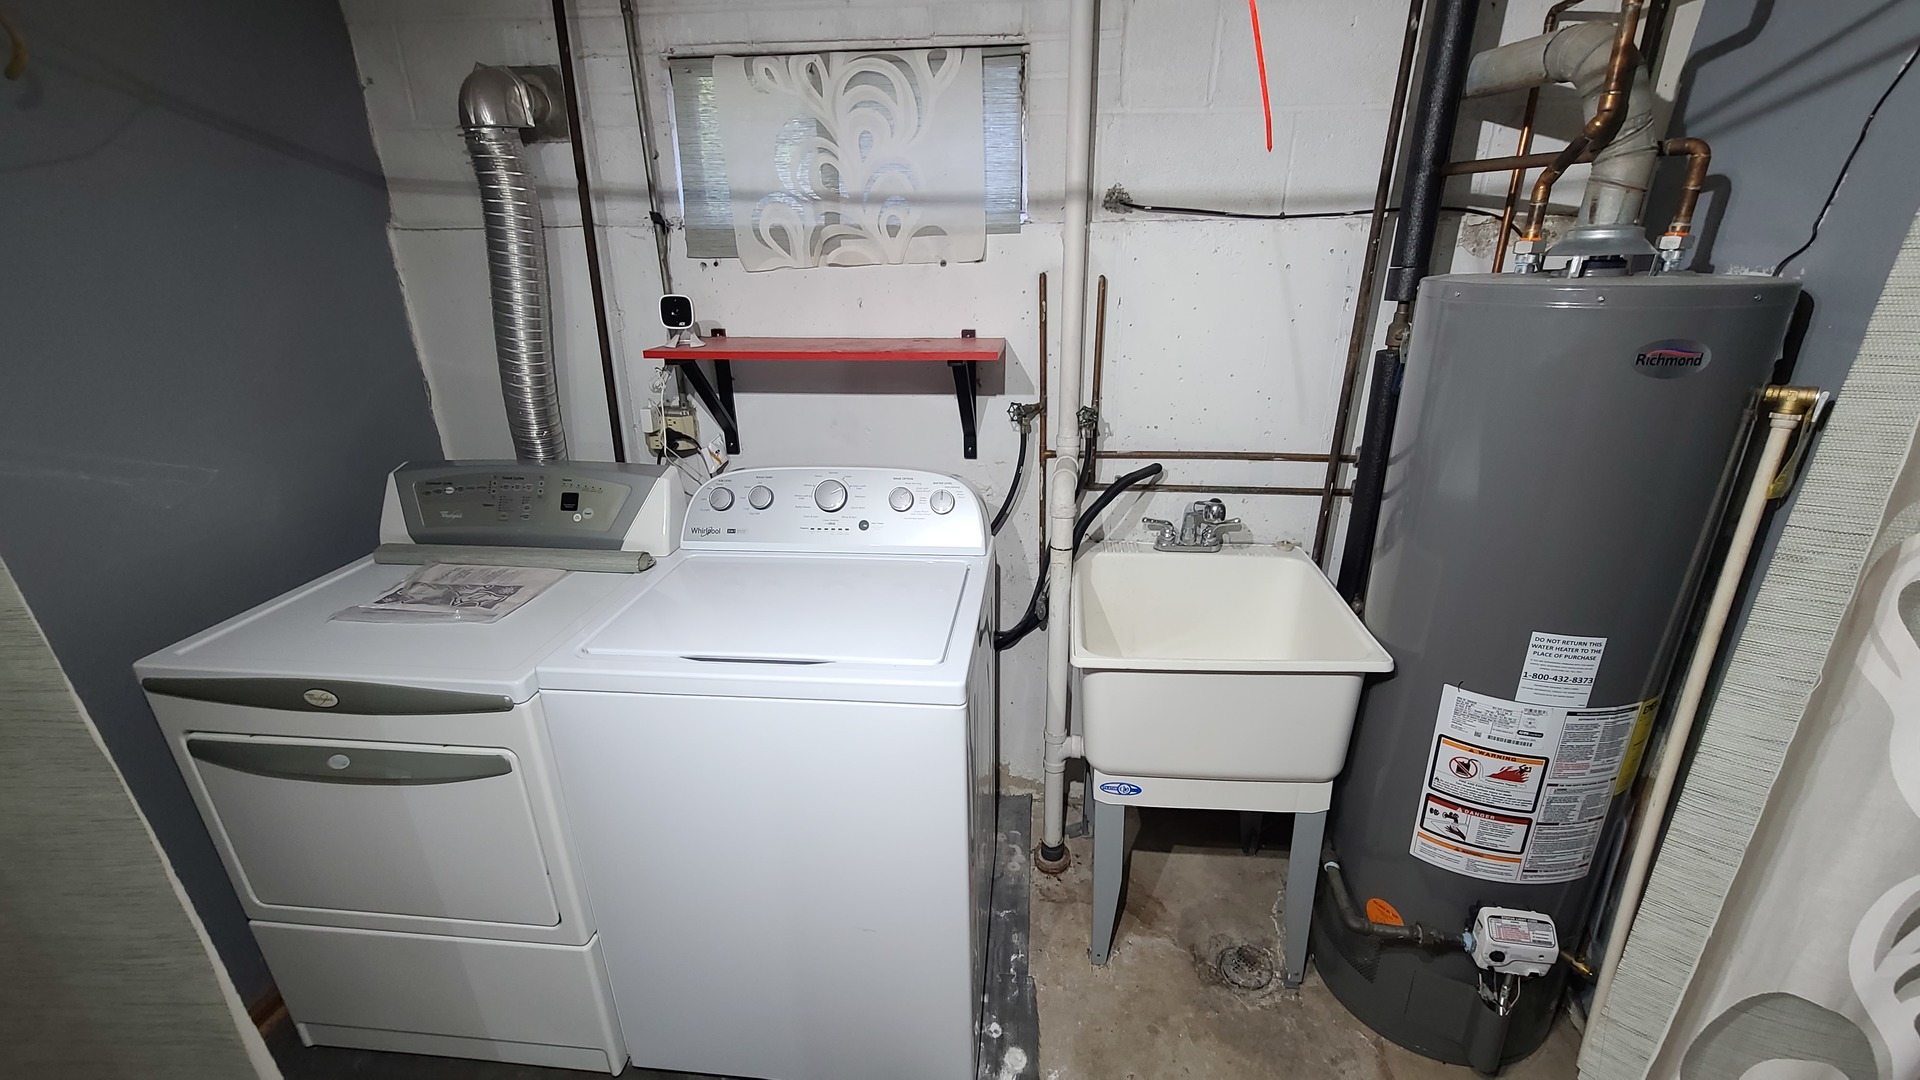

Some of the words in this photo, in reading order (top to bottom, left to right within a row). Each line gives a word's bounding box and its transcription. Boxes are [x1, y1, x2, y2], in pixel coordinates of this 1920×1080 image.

[1635, 352, 1704, 366] Richmond
[690, 526, 720, 537] Whirlpool
[1523, 672, 1593, 684] 1-800-432-8373
[1478, 750, 1517, 762] WARNING
[1464, 809, 1495, 820] DANGER
